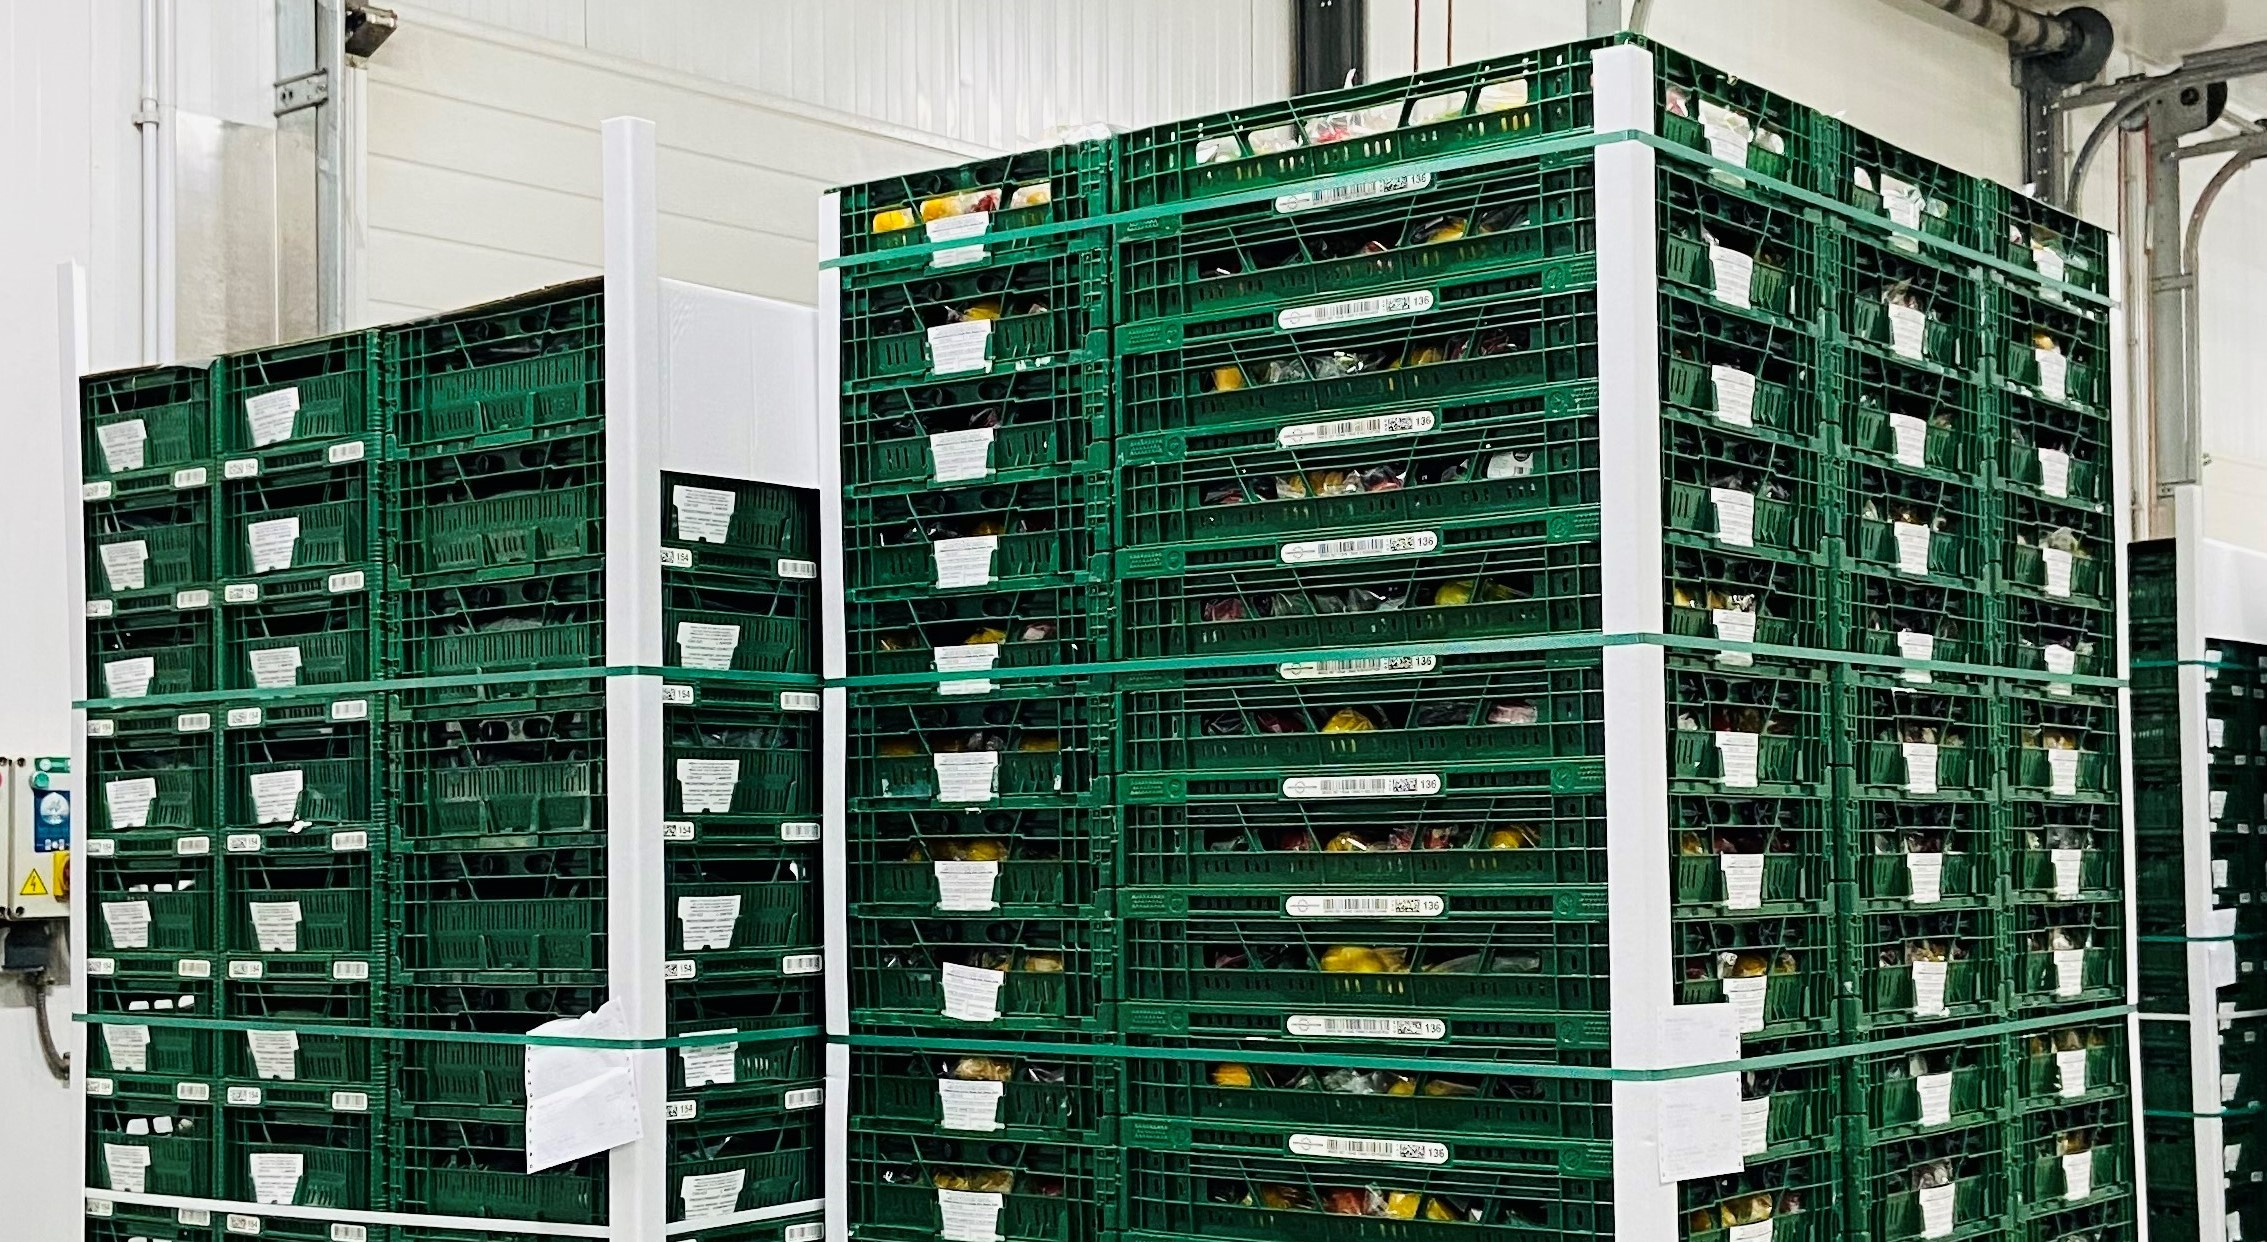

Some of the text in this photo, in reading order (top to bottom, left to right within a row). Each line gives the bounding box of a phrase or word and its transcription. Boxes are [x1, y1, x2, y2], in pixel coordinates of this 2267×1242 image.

[1411, 173, 1427, 183] 136
[1414, 296, 1430, 306] 136
[1415, 416, 1431, 426] 136
[1418, 536, 1434, 546] 136
[677, 552, 689, 562] 154
[1415, 656, 1432, 666] 136
[678, 690, 691, 699] 154
[1420, 779, 1436, 789] 136
[679, 826, 691, 834] 154
[1424, 900, 1440, 910] 136
[680, 964, 692, 973] 154
[1425, 1024, 1442, 1034] 136
[680, 1105, 693, 1114] 154
[1428, 1148, 1445, 1159] 136
